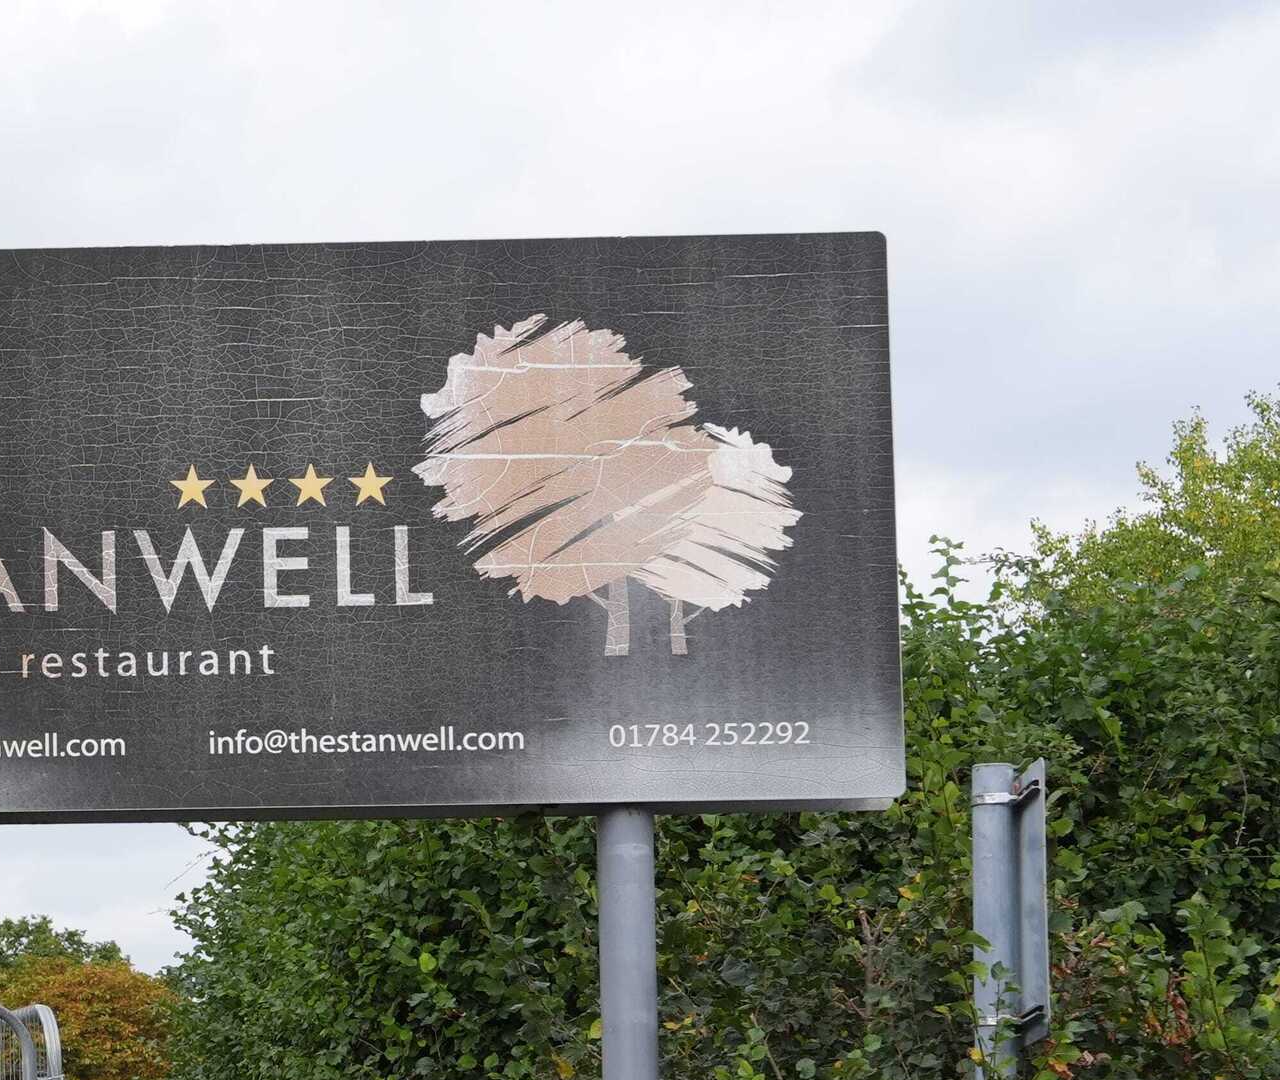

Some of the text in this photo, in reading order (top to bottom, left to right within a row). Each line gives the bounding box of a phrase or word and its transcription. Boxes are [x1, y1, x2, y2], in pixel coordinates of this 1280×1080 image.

[21, 643, 276, 680] restaurant
[208, 725, 526, 755] info@thestanwell.com
[608, 720, 812, 748] 01784 252292
